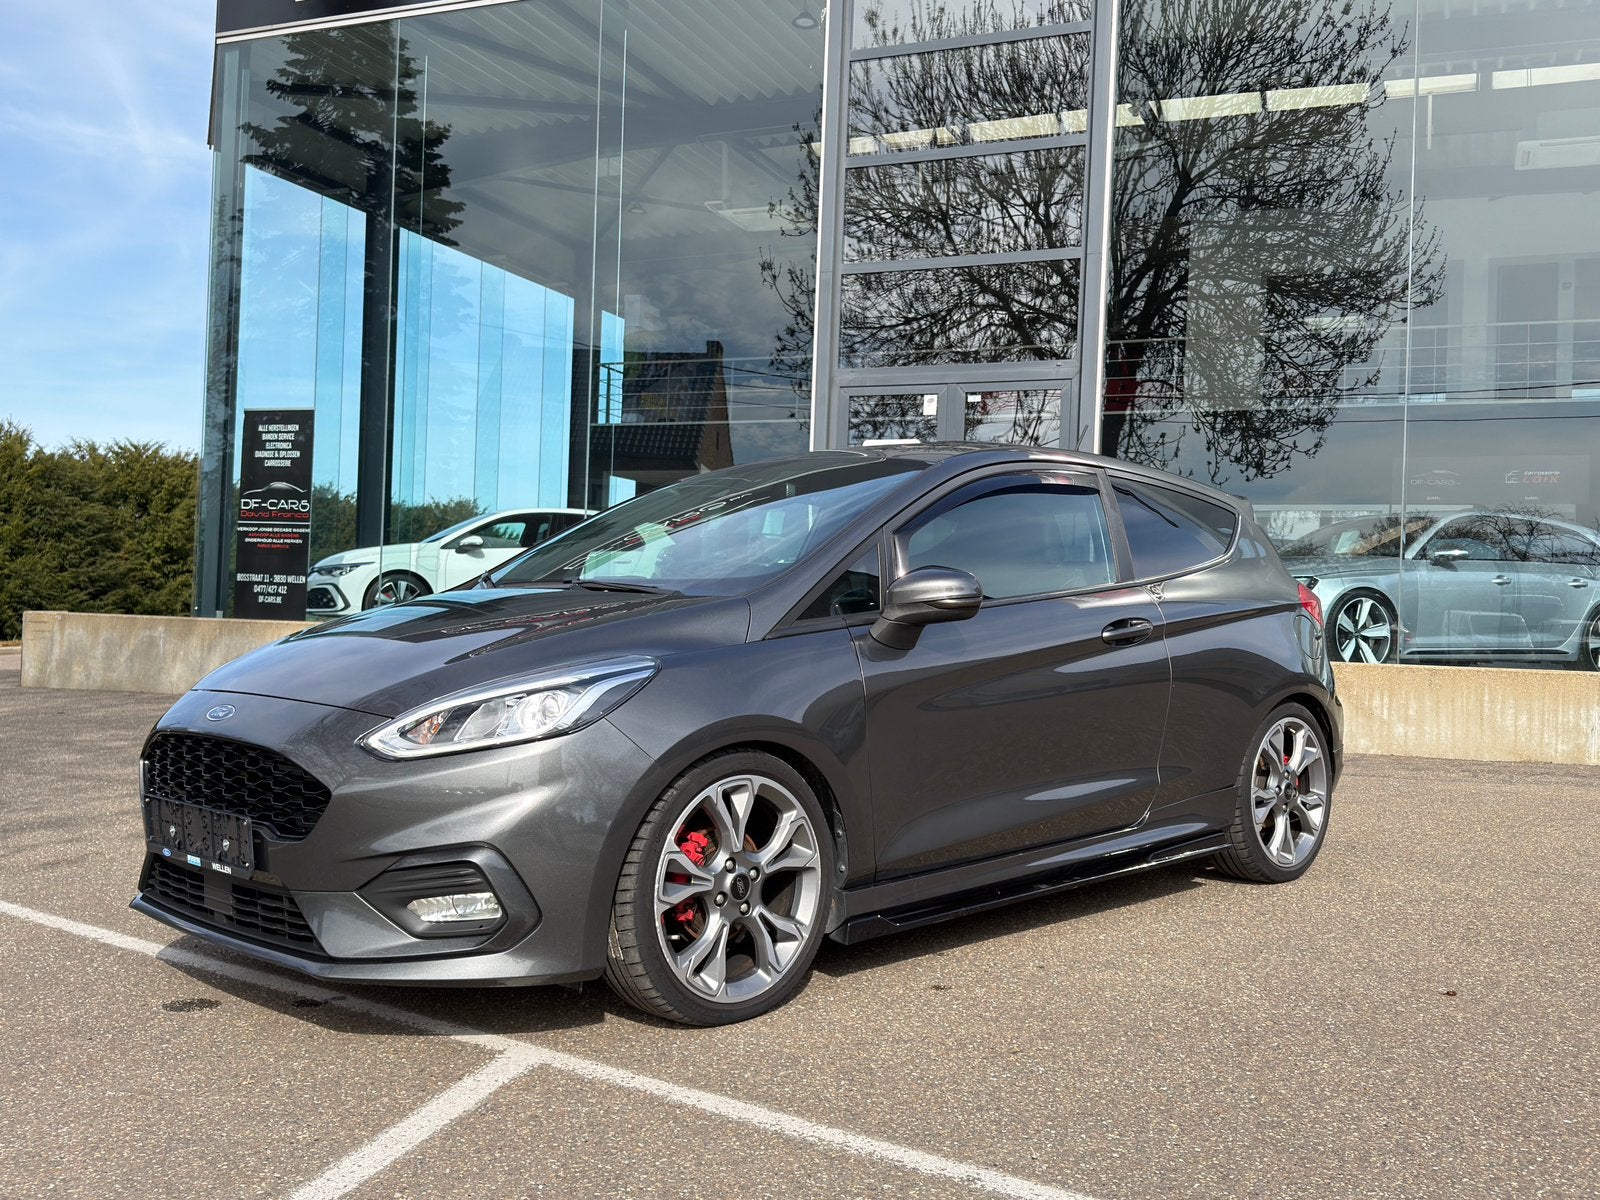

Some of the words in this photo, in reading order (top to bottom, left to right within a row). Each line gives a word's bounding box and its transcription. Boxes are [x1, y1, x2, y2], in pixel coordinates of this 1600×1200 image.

[241, 500, 310, 512] DF-CARS
[237, 573, 263, 582] BOSSTRAAT
[264, 574, 269, 582] 11
[273, 575, 286, 583] 3830
[287, 575, 306, 584] WELLEN
[254, 585, 277, 594] 0477/427
[278, 585, 287, 594] 412
[211, 862, 232, 875] WELLEN
